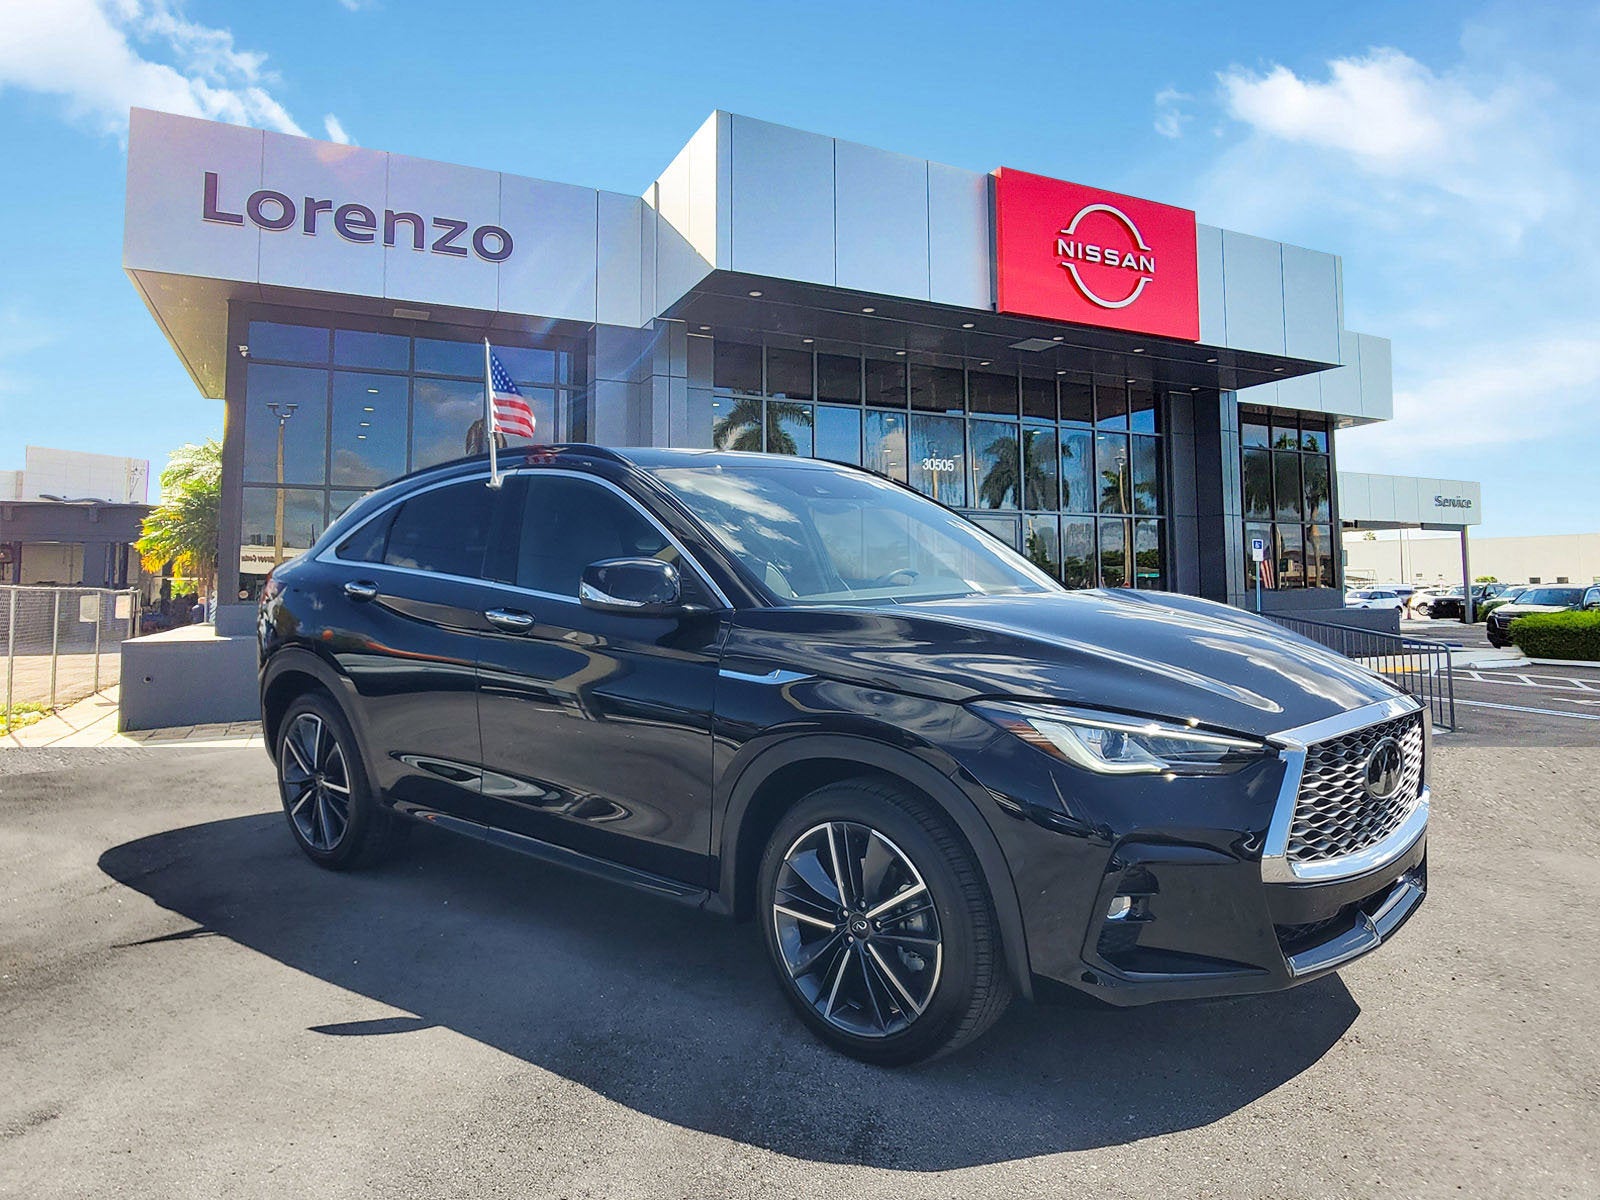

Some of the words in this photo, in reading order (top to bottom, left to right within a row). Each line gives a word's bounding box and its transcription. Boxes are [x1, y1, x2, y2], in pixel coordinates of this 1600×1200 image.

[202, 171, 514, 262] Lorenzo
[1057, 238, 1155, 273] NISSAN
[922, 458, 955, 471] 30505
[1434, 495, 1472, 508] Service
